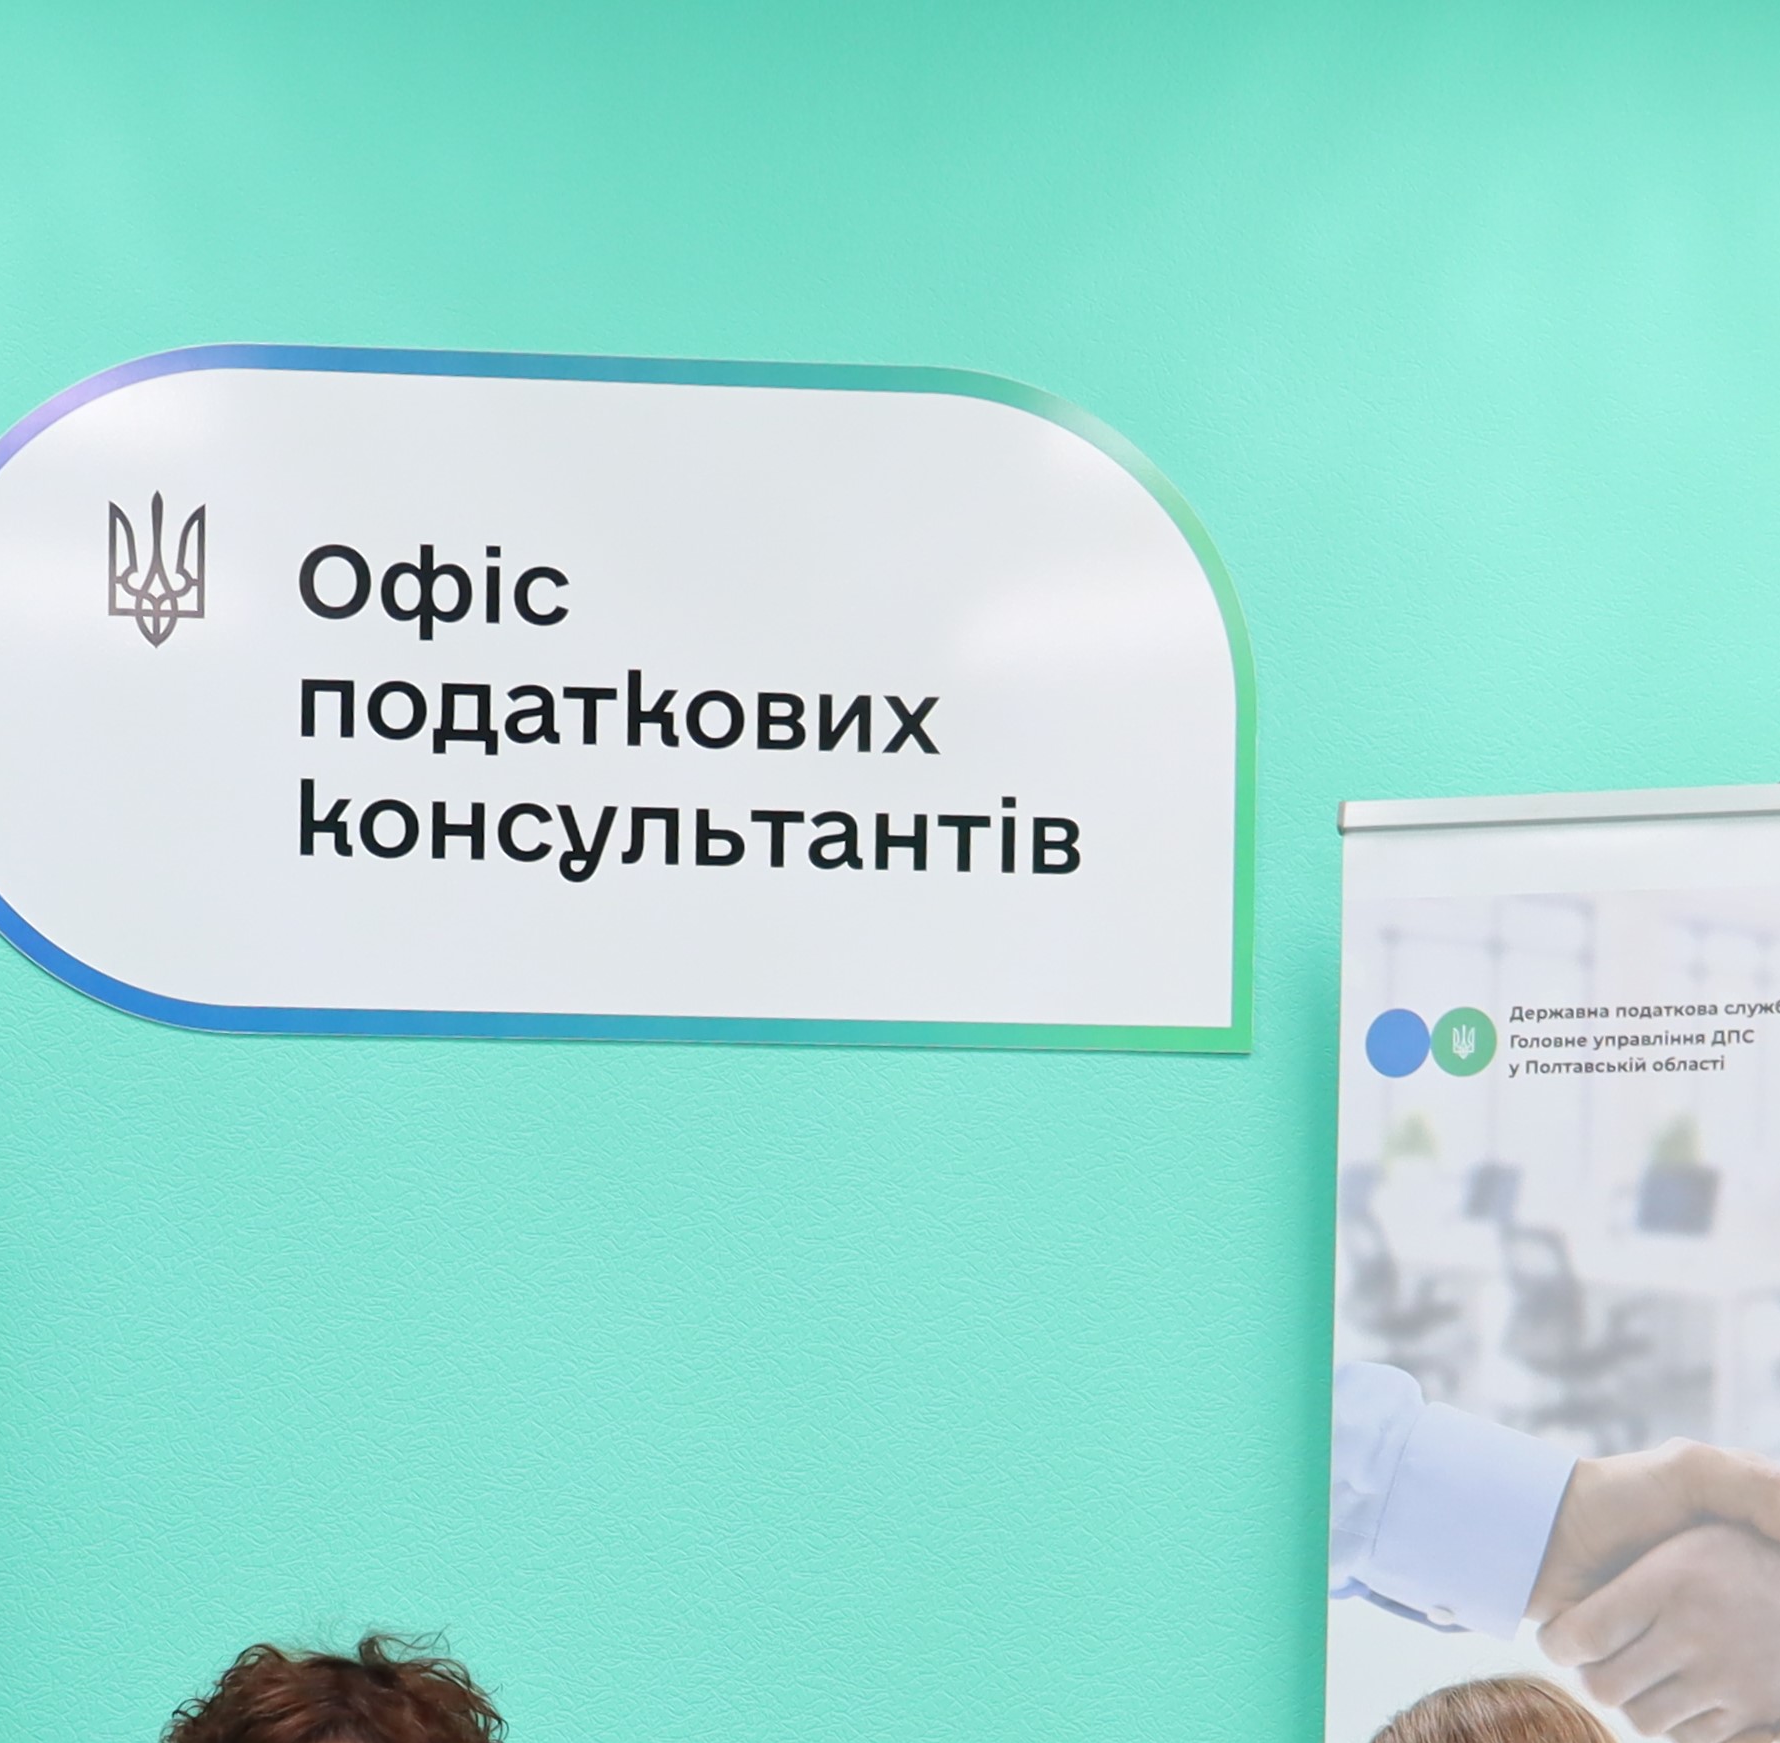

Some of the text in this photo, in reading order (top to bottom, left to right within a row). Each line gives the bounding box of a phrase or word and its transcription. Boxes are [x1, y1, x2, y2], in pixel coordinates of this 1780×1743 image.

[297, 543, 570, 641] Офіс
[299, 671, 941, 755] податкових
[299, 778, 1083, 883] консультантів
[1509, 1005, 1610, 1022] Державна
[1615, 1003, 1718, 1020] податкова
[1508, 1055, 1726, 1078] у Полтавській області
[1509, 1029, 1755, 1051] Головне управління ДПС
